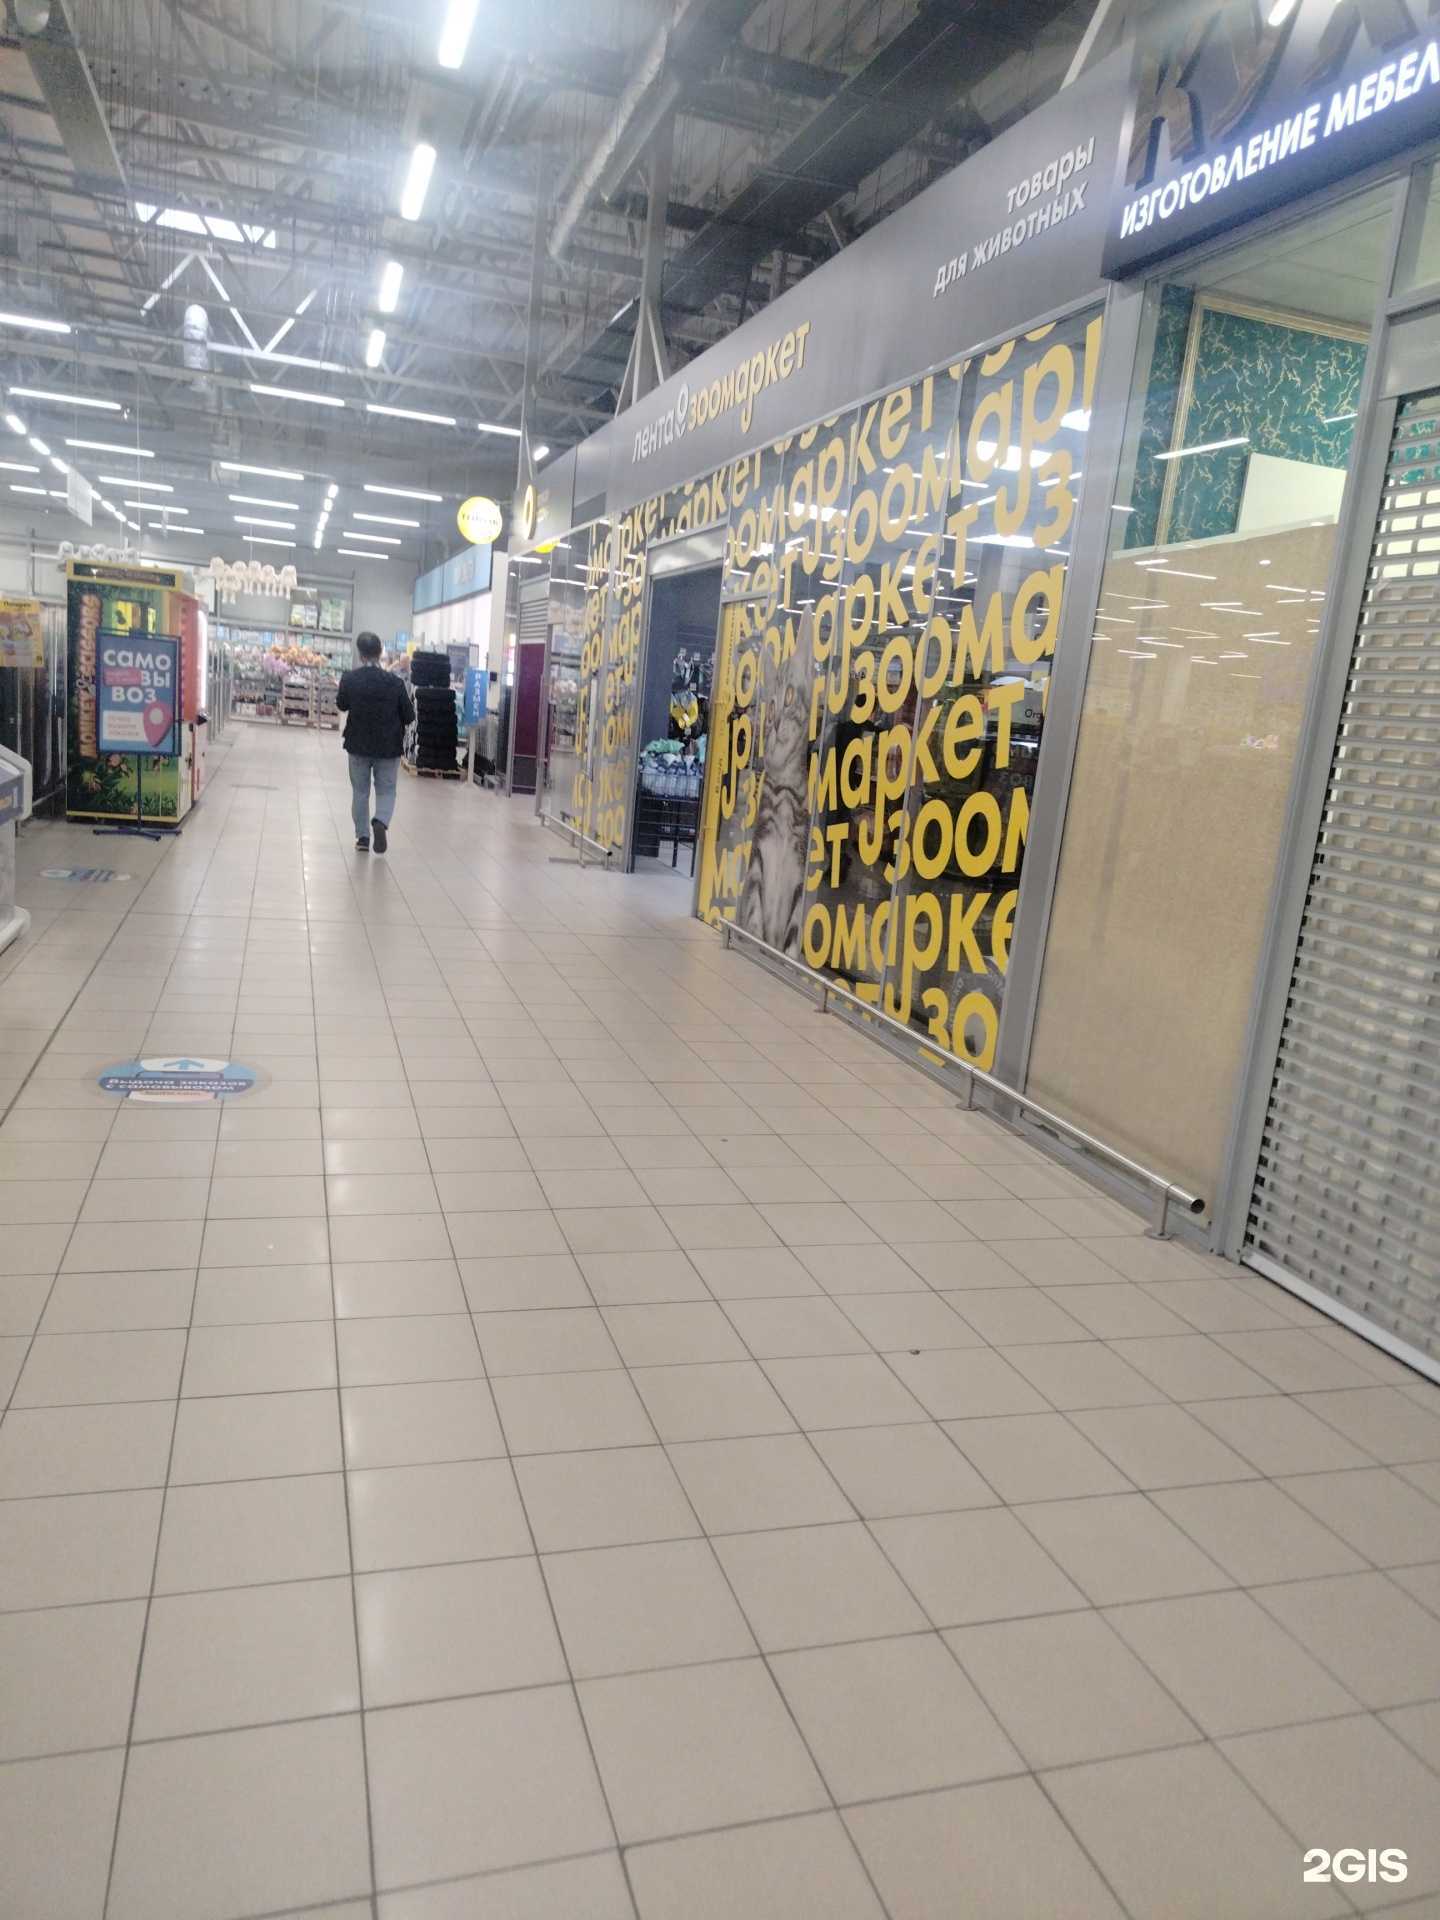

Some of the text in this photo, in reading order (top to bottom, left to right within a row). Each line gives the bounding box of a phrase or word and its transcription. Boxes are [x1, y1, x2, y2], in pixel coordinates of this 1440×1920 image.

[1006, 136, 1096, 215] товары
[1120, 42, 1440, 239] ИЗГОТОВЛЕНИЕ МЕБЕЛ
[933, 182, 1087, 298] для животных
[632, 320, 812, 464] лента зоомаркет
